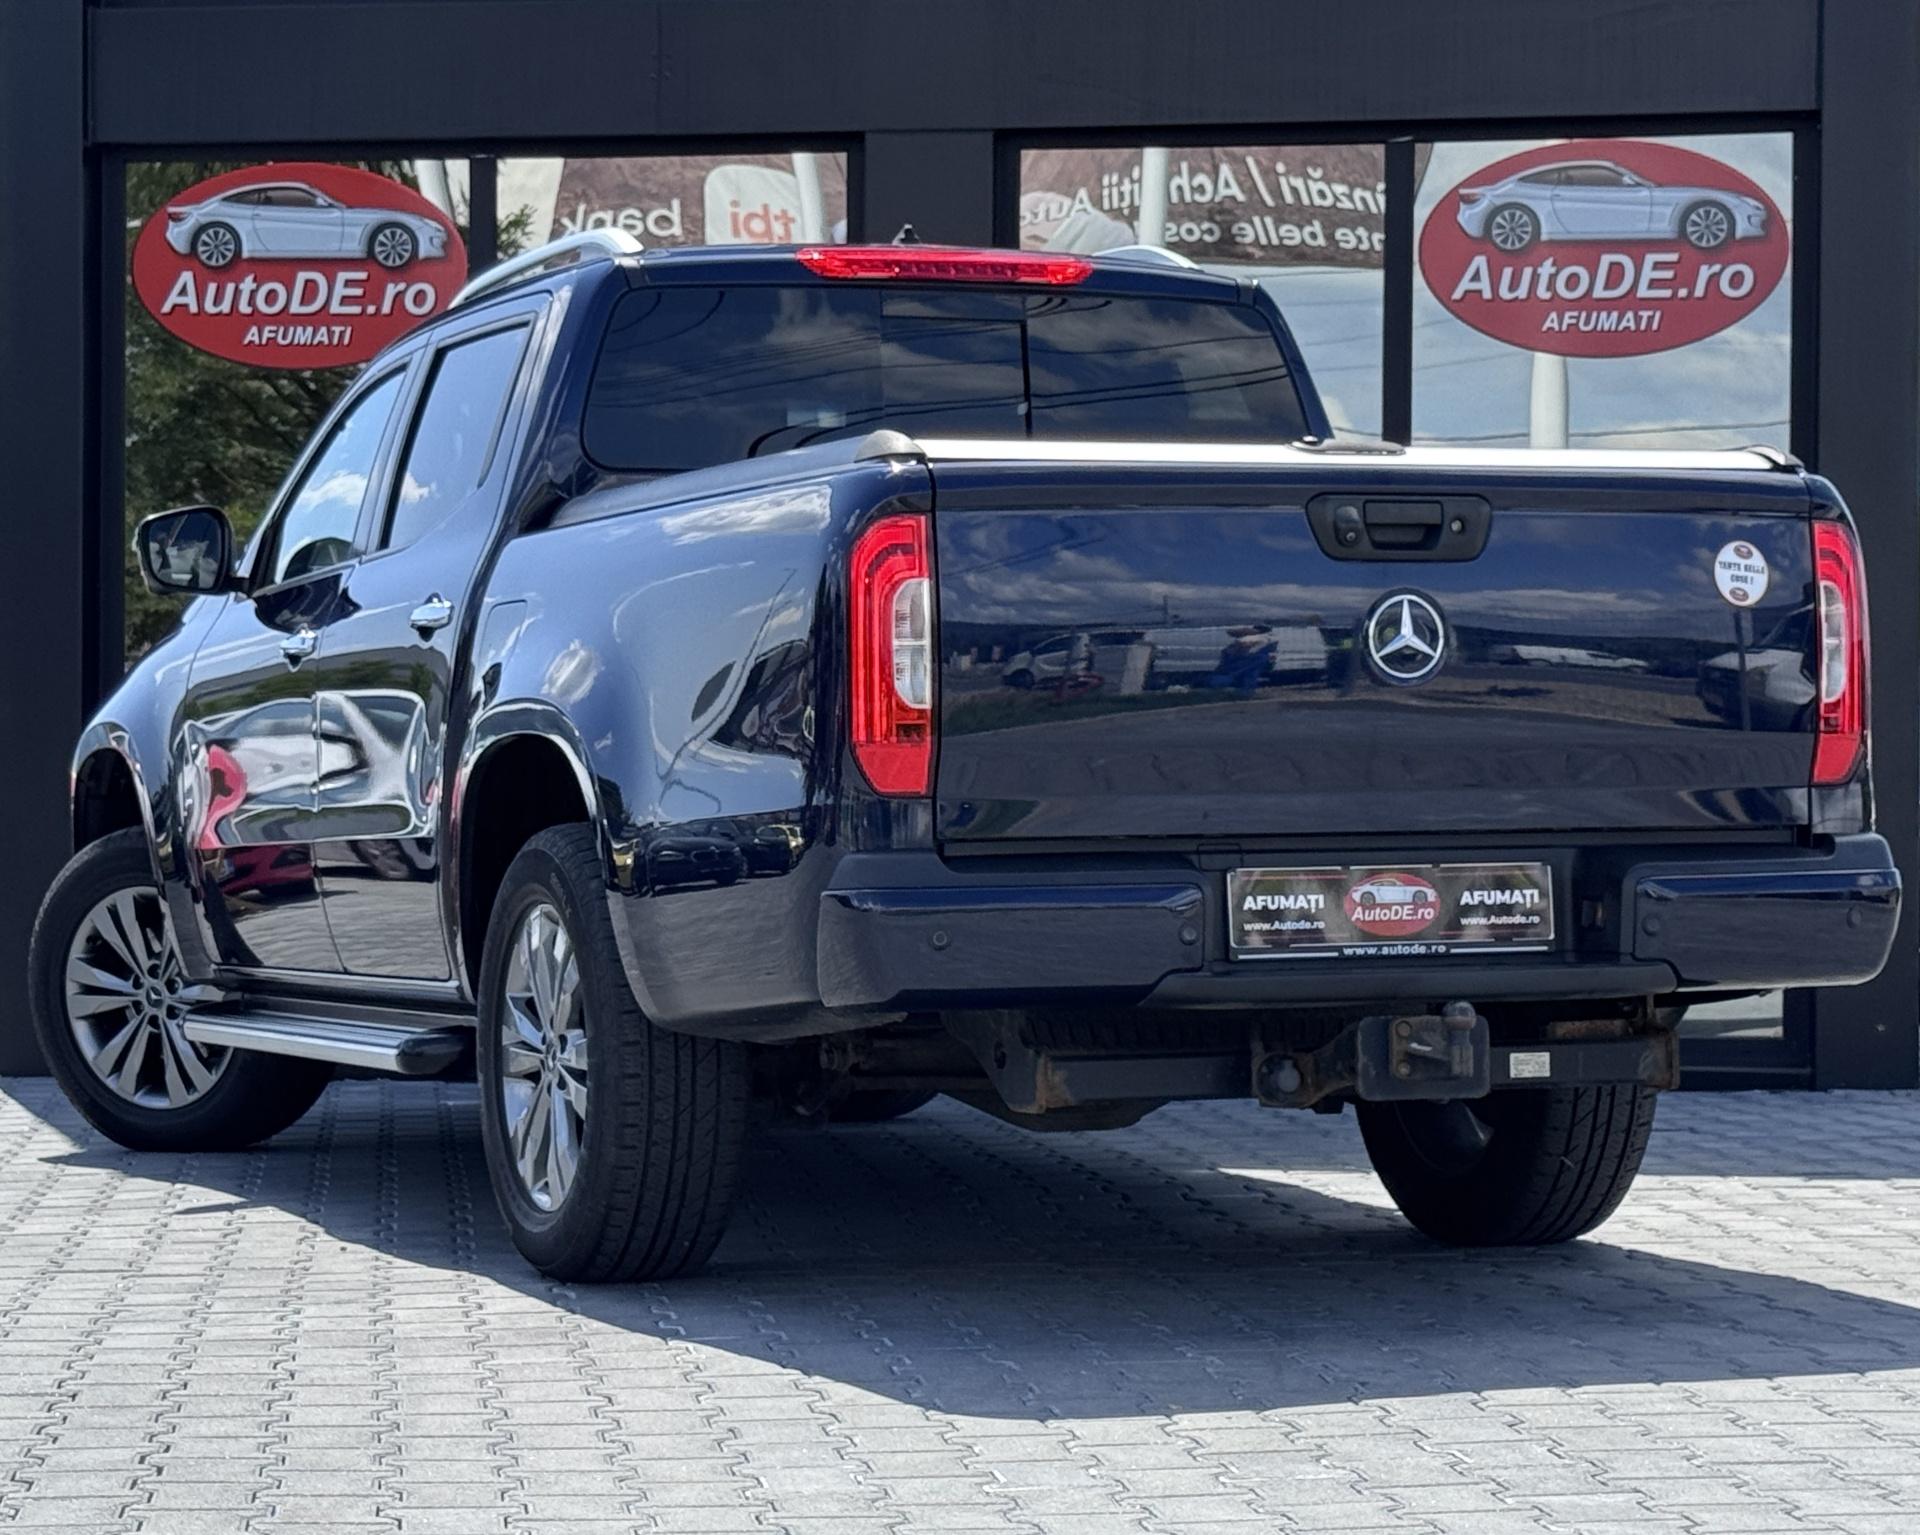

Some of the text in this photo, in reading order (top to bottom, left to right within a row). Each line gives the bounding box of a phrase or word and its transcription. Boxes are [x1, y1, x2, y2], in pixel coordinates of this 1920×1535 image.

[1451, 252, 1755, 301] AutoDE.ro
[160, 270, 437, 315] AutoDE.ro
[1542, 310, 1661, 332] AFUMATI
[243, 325, 352, 347] AFUMATI
[1351, 905, 1435, 922] AutoDE.ro
[1459, 914, 1541, 926] www.Autode.ro
[1243, 920, 1326, 932] www.Autode.ro
[1342, 944, 1447, 956] www.autode.ro
